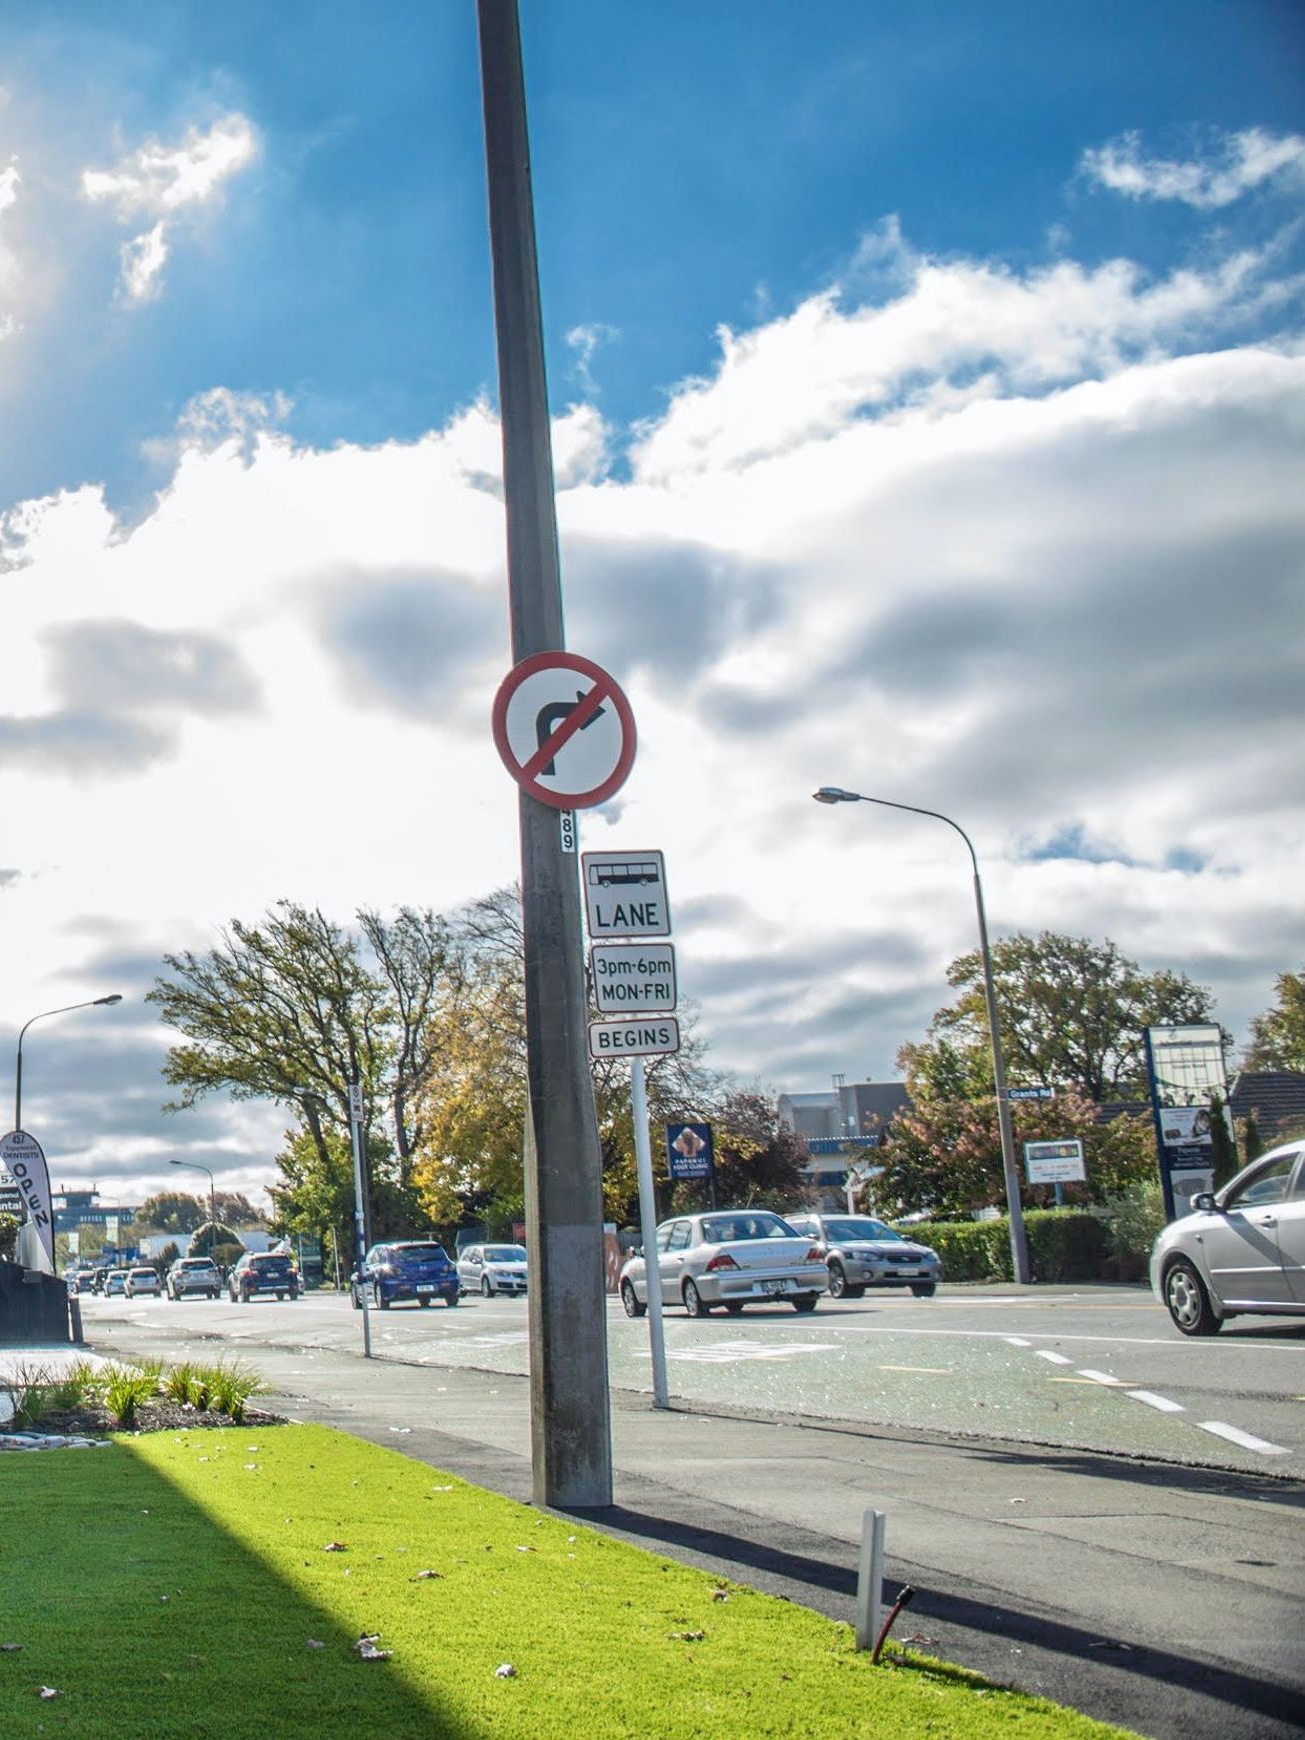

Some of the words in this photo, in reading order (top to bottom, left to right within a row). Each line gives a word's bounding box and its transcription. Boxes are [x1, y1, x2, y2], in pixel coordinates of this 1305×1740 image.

[596, 903, 659, 927] LANE
[597, 958, 671, 977] 3pm-6pm
[602, 983, 670, 1000] MON-FRI
[599, 1027, 670, 1048] BEGINS
[12, 1135, 25, 1145] 457
[13, 1163, 49, 1228] OPEN
